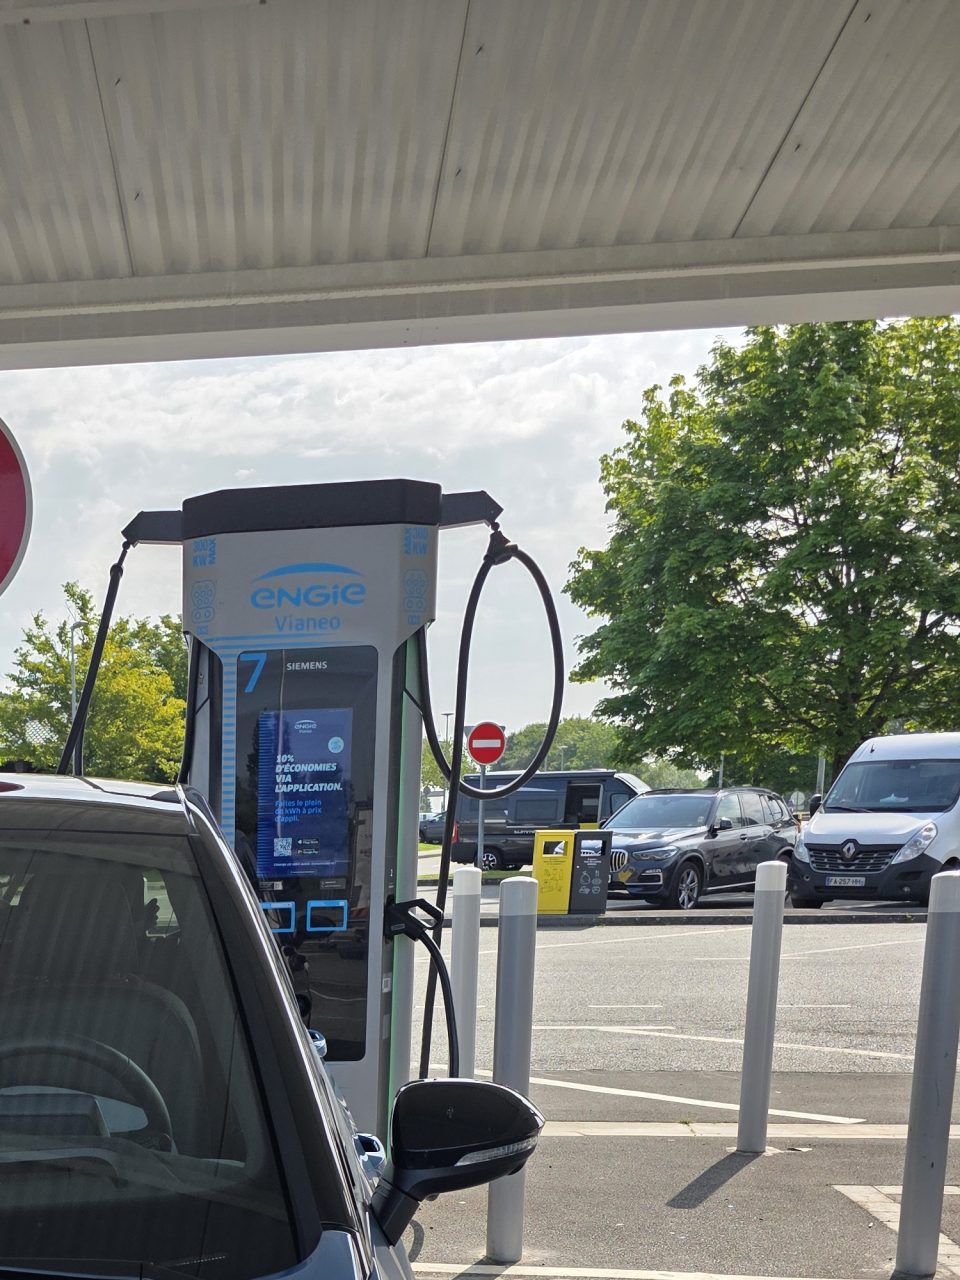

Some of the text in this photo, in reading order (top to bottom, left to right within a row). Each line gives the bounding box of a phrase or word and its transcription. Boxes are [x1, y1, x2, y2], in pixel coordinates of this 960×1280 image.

[275, 615, 341, 633] Vianeo
[286, 660, 328, 671] SIEMENS
[240, 652, 267, 694] 7
[276, 754, 295, 763] 10%
[275, 762, 337, 773] D'ÉCONOMIES
[275, 774, 292, 783] VIA
[275, 782, 343, 793] L'APPLICATION.
